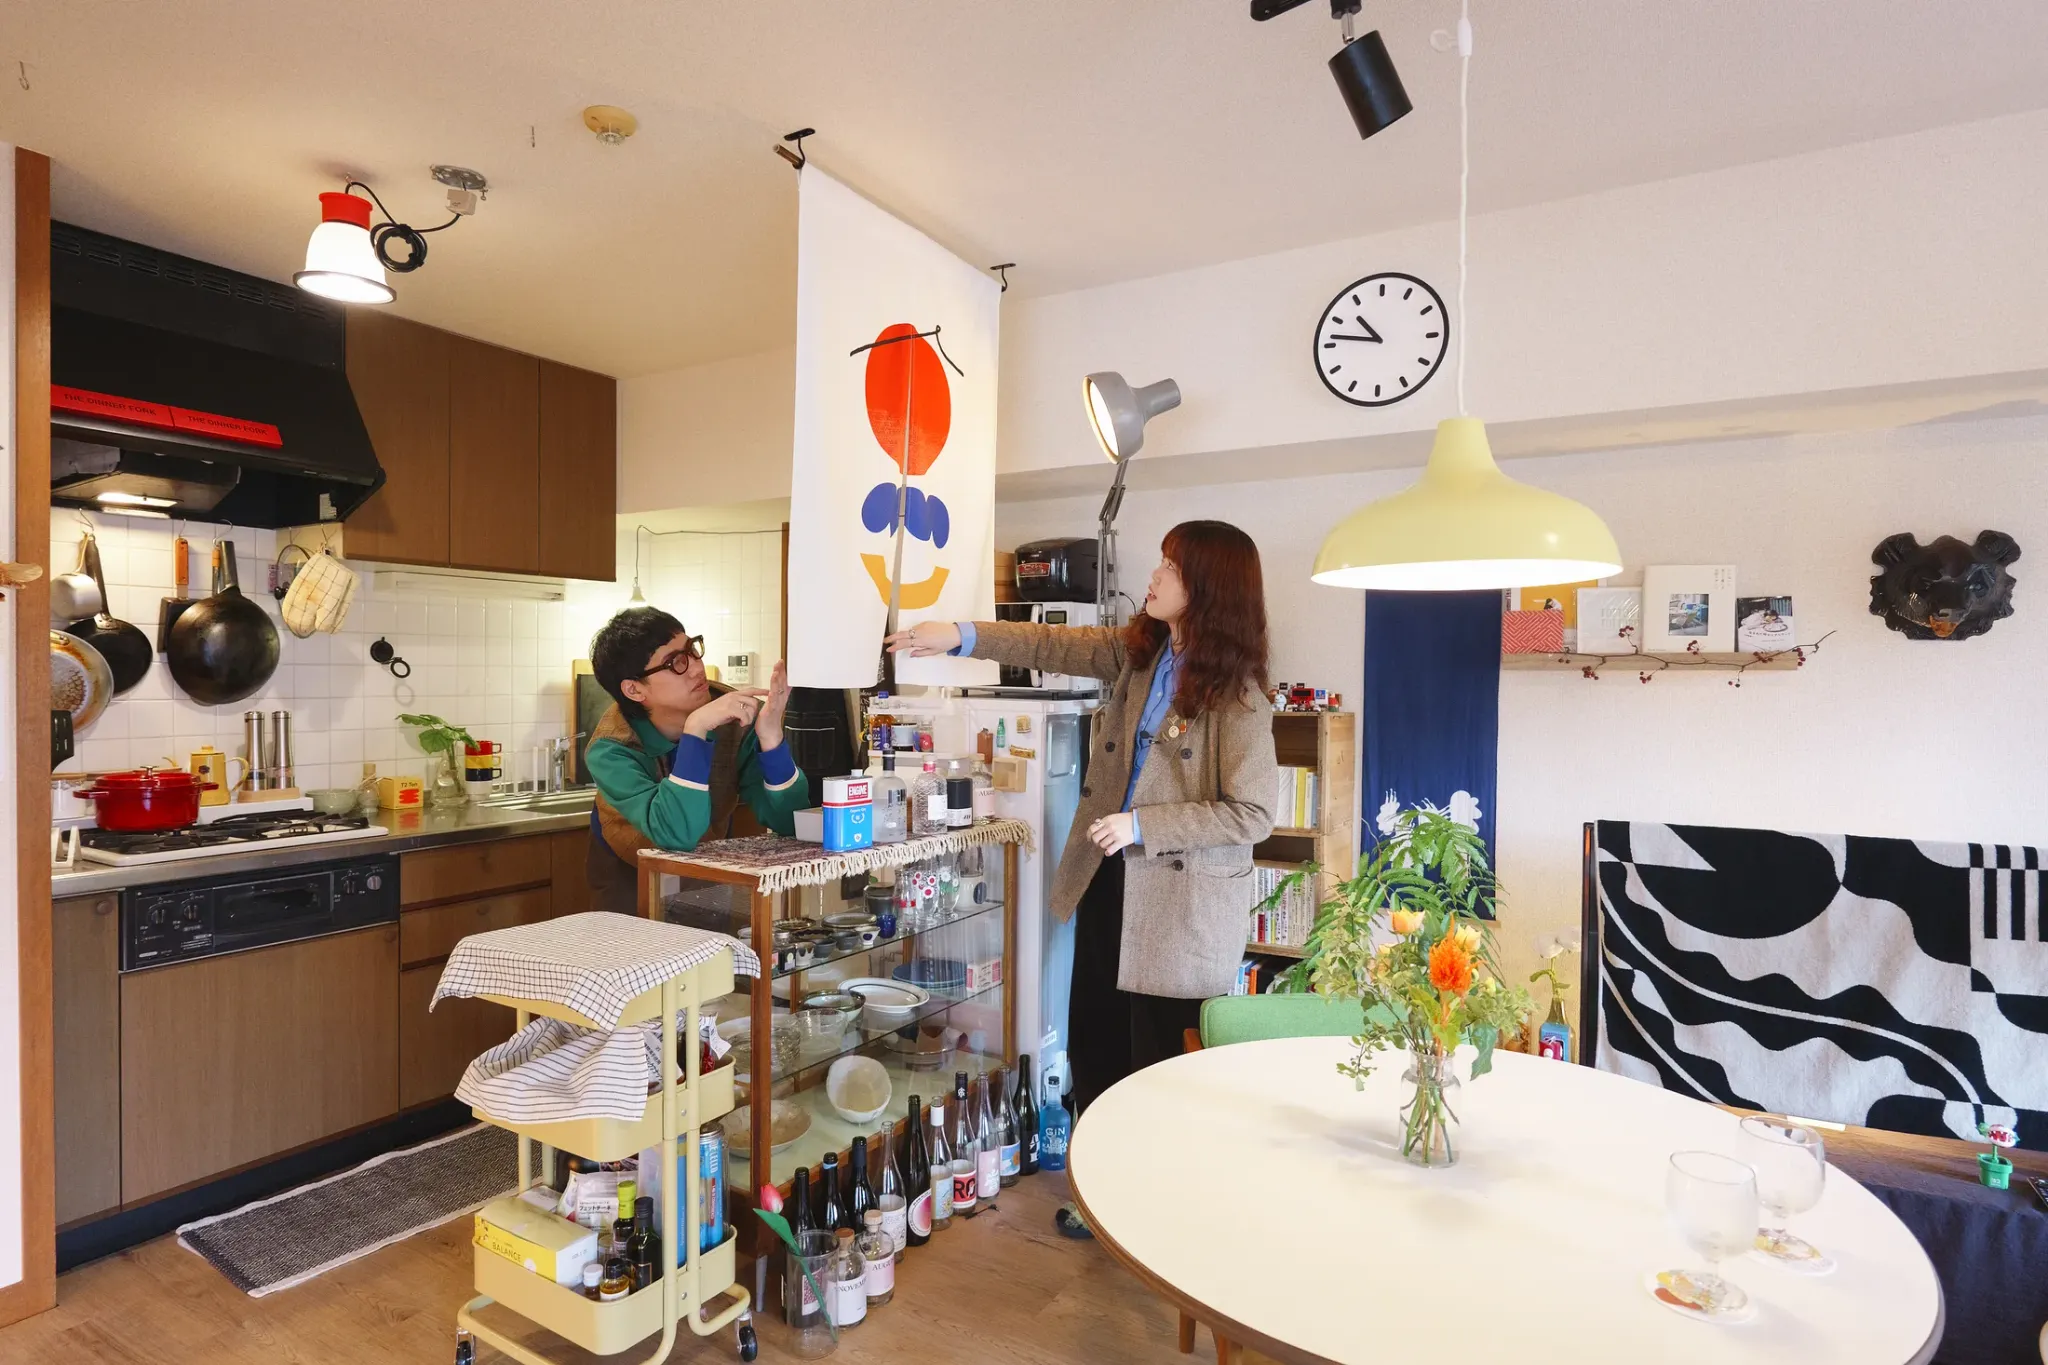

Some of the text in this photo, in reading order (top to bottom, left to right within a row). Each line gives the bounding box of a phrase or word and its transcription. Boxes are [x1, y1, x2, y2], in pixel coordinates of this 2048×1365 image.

[64, 393, 157, 416] THE DINNER FORK
[187, 415, 268, 436] THE DINNER FORK
[848, 785, 868, 797] ENGINE
[1045, 1127, 1066, 1136] GIN
[492, 1241, 521, 1262] BALANCE
